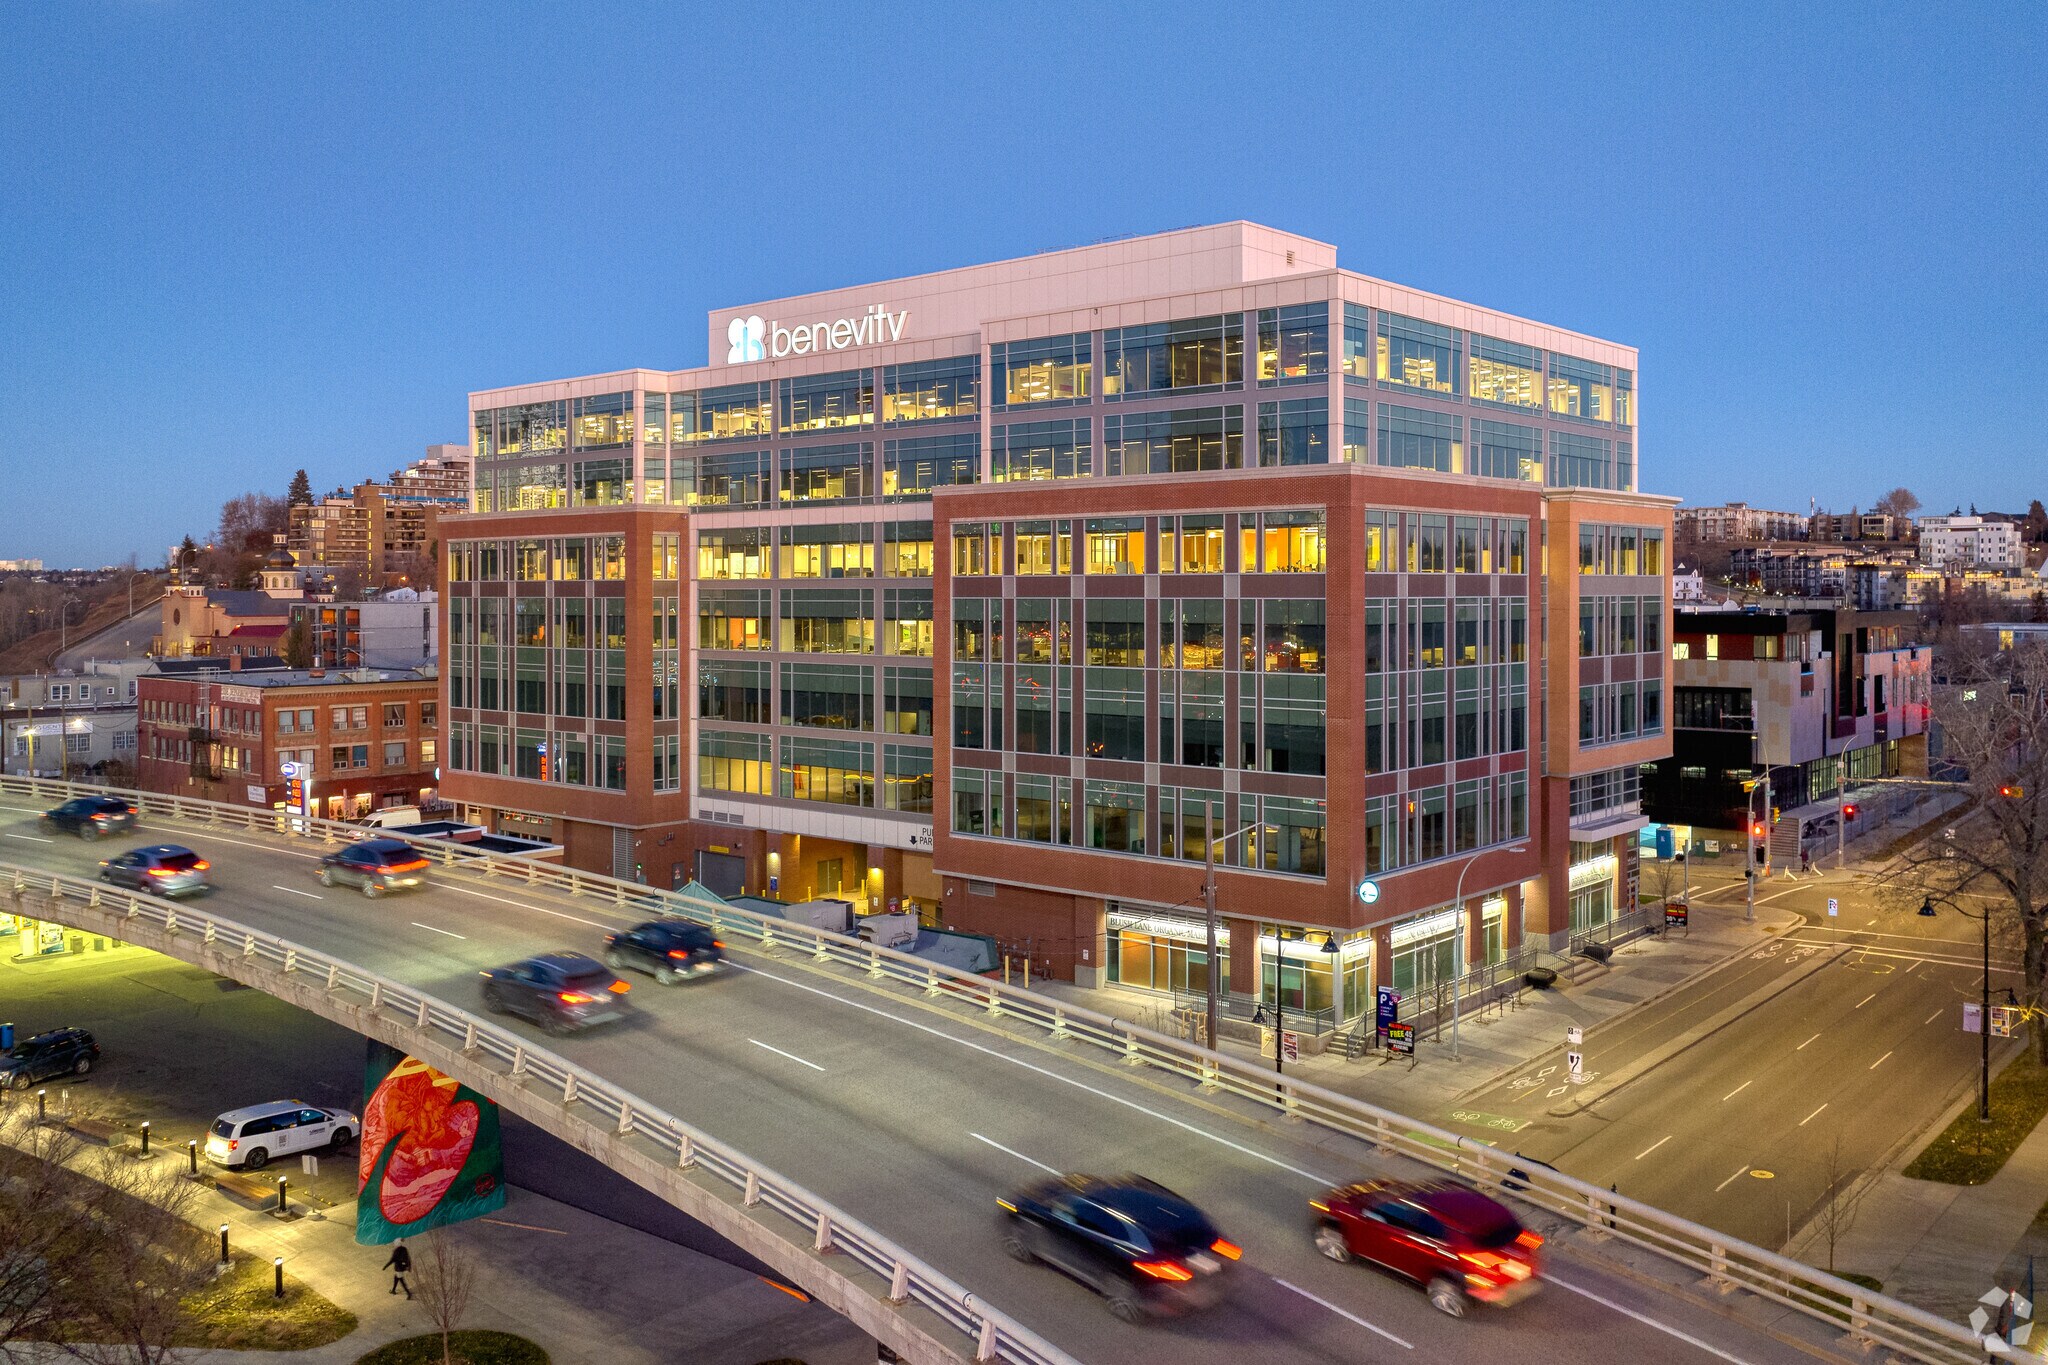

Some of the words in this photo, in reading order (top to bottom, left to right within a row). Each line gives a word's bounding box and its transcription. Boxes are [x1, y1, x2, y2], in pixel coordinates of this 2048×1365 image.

[922, 828, 933, 836] PU
[1134, 921, 1153, 932] LANE
[1380, 994, 1387, 1004] P
